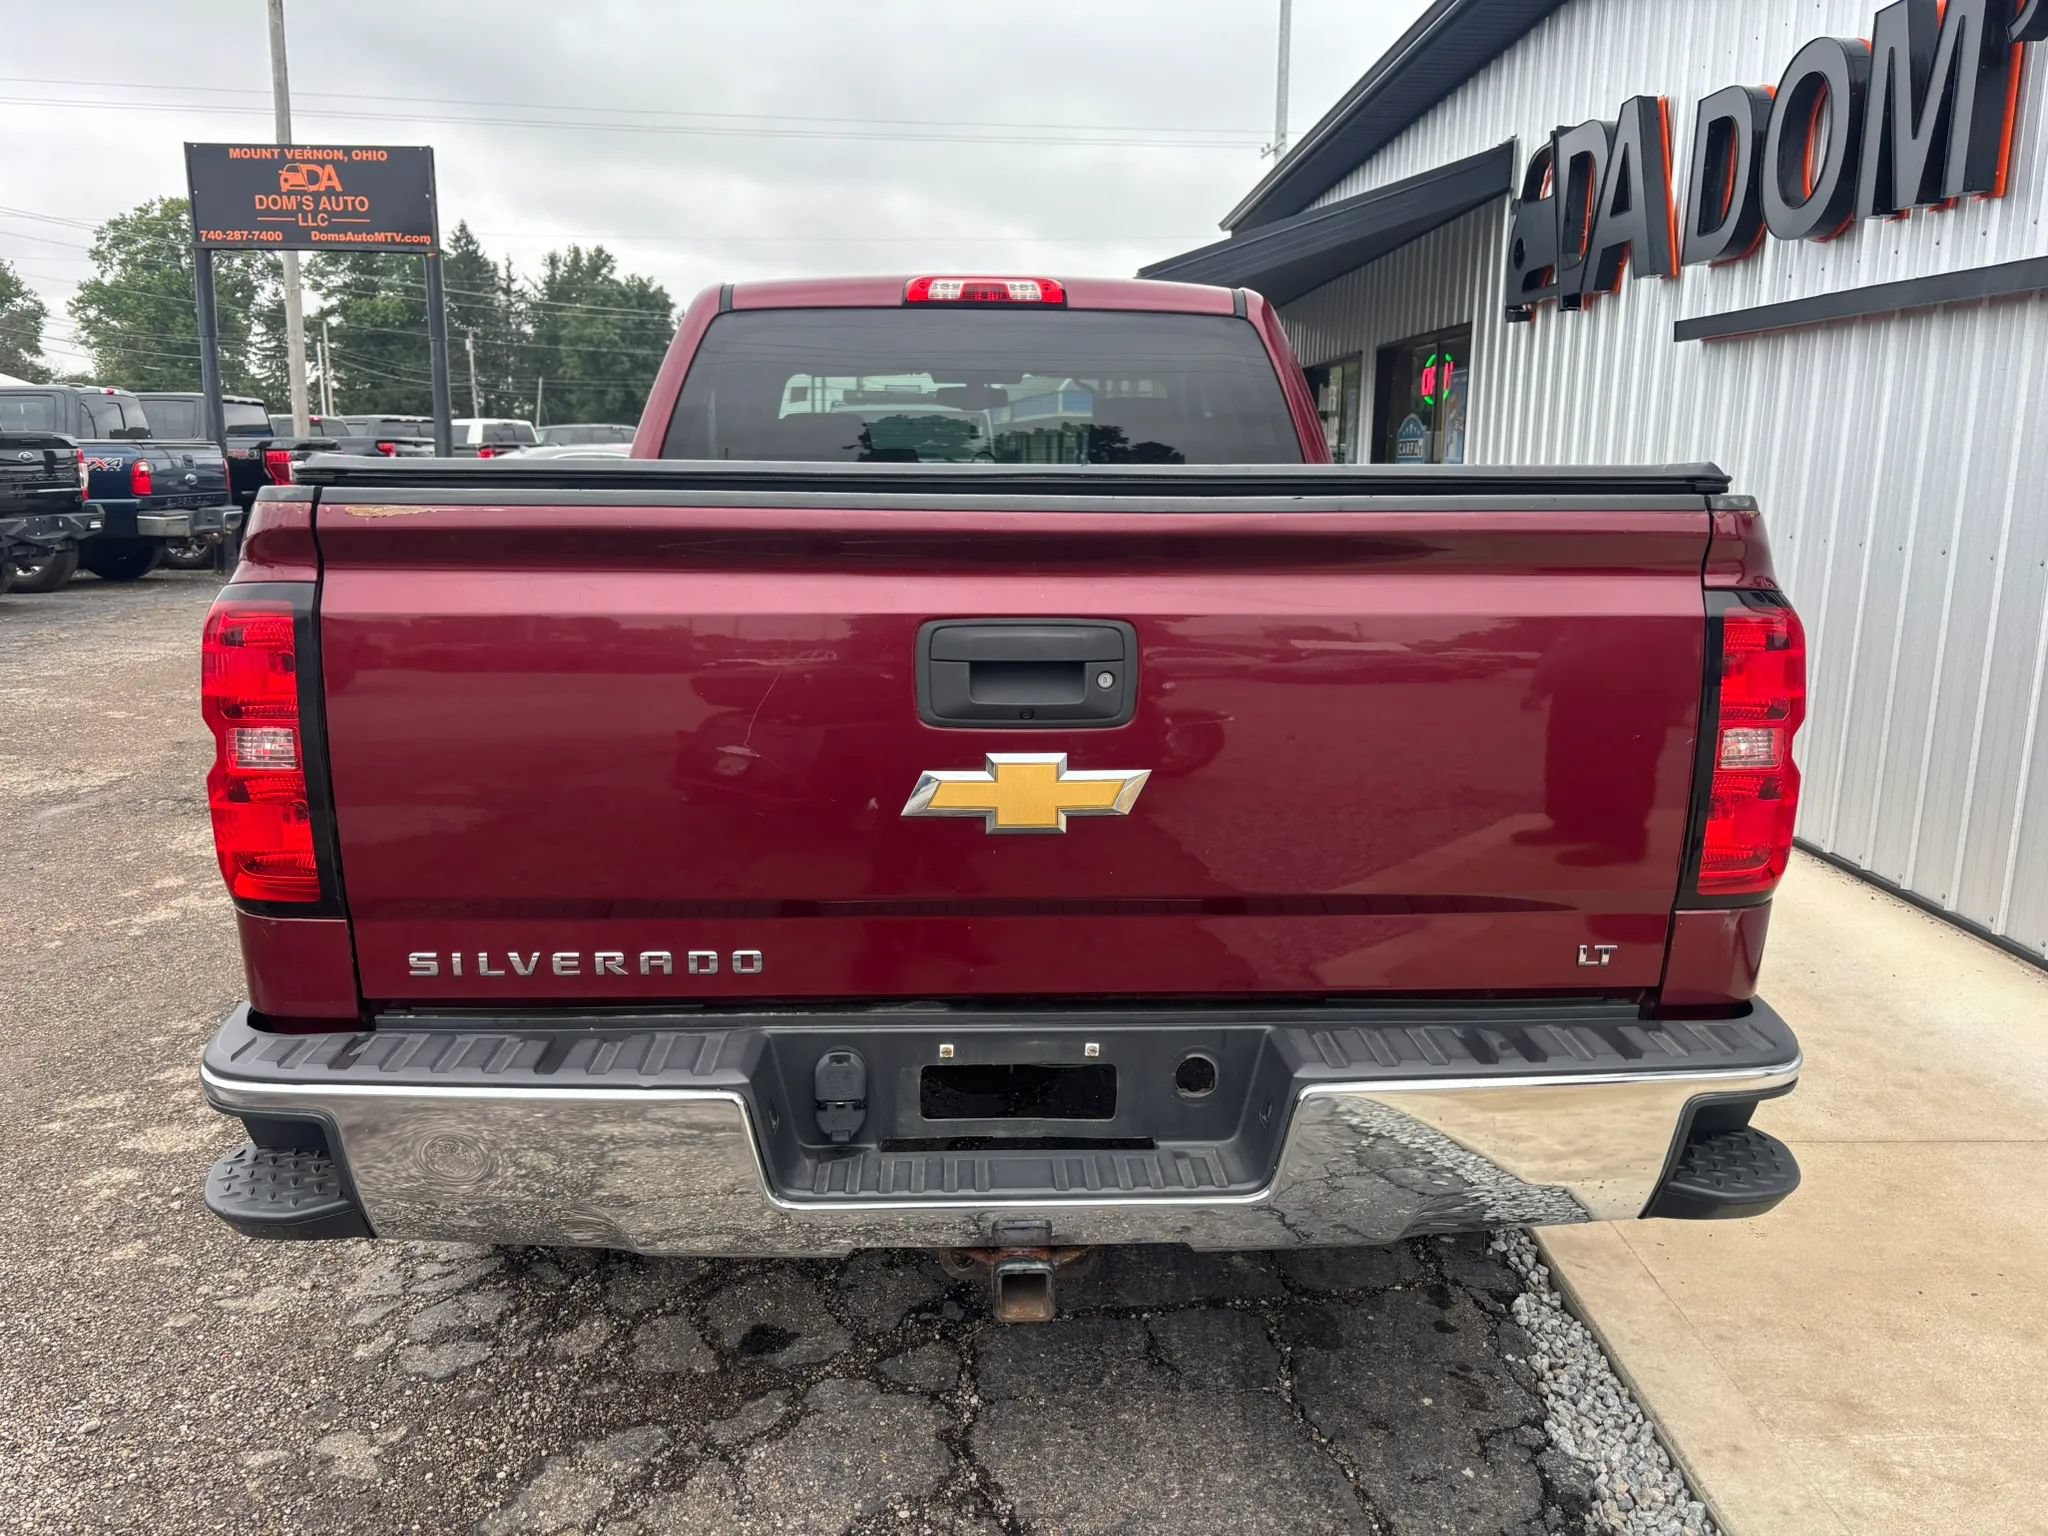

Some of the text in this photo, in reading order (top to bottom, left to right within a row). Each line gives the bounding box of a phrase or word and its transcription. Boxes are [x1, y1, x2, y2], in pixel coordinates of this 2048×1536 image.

[229, 148, 388, 162] MOUNT VERNON, OHIO
[254, 195, 369, 212] DOM'S AUTO
[298, 213, 328, 227] LLC
[200, 230, 432, 245] 740-287-7400 DomsAutoMTV.com
[1577, 944, 1619, 966] LT
[408, 951, 764, 976] SILVERADO
